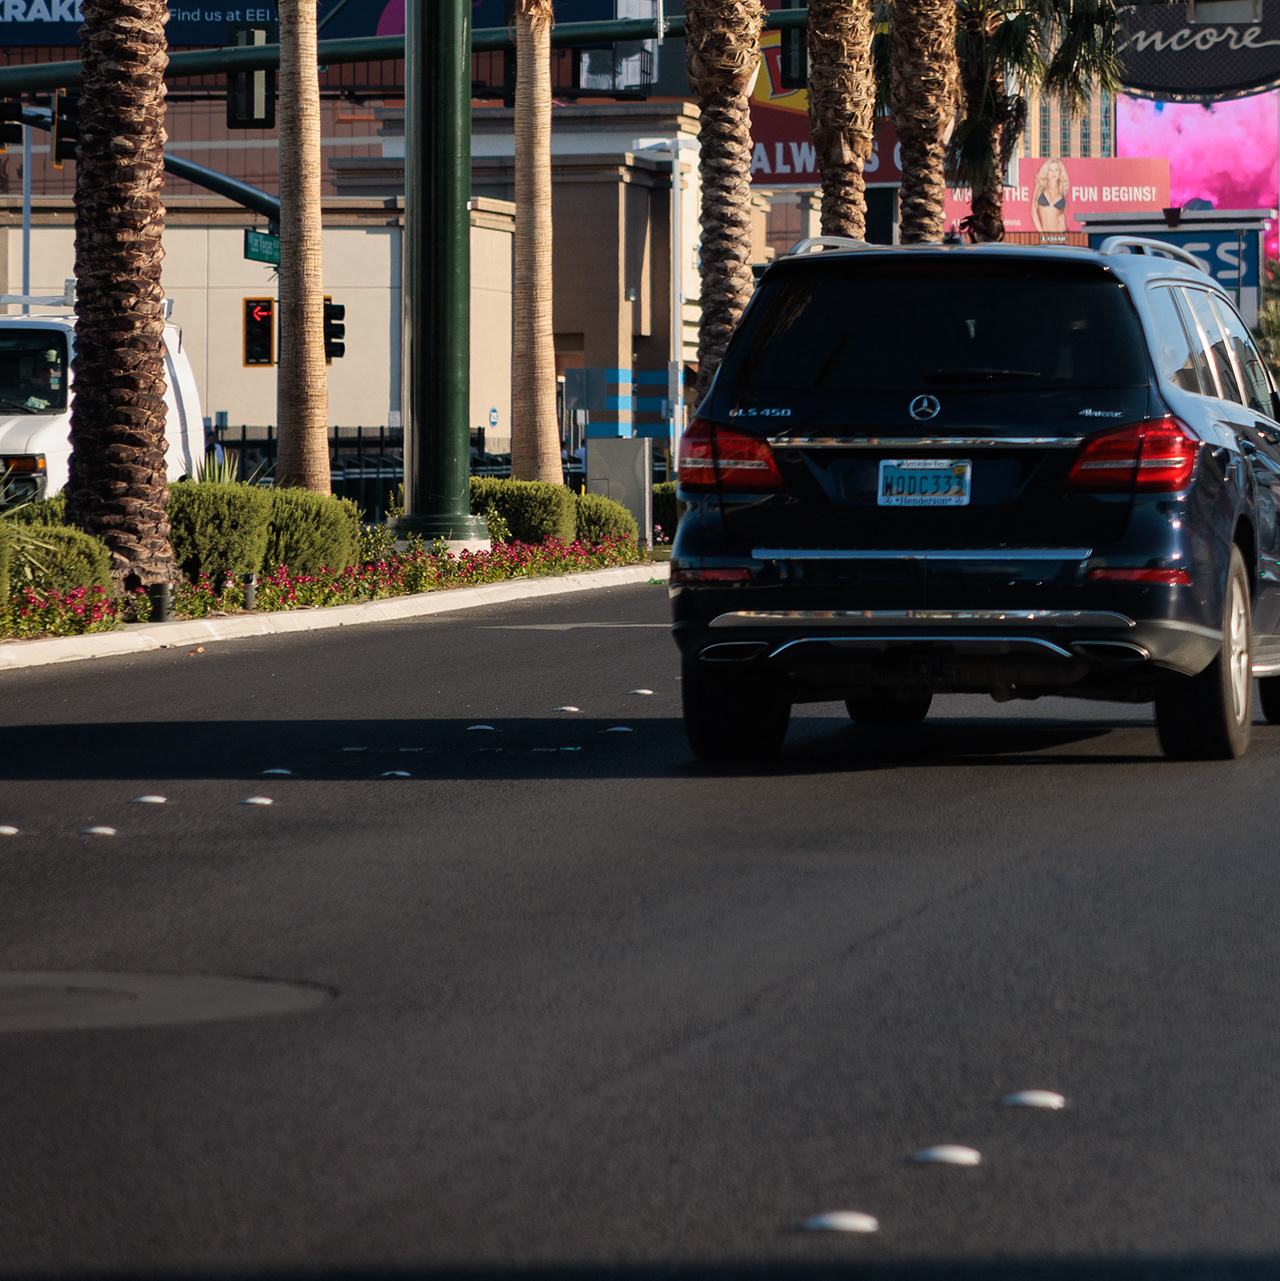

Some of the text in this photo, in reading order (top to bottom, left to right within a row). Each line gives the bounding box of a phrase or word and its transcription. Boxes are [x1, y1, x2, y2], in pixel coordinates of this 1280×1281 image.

[169, 8, 201, 22] Find
[205, 11, 222, 22] us
[226, 9, 242, 22] at
[246, 9, 270, 21] EEI
[1003, 186, 1156, 202] THE FUN BEGINS!
[728, 408, 792, 417] GLS 450
